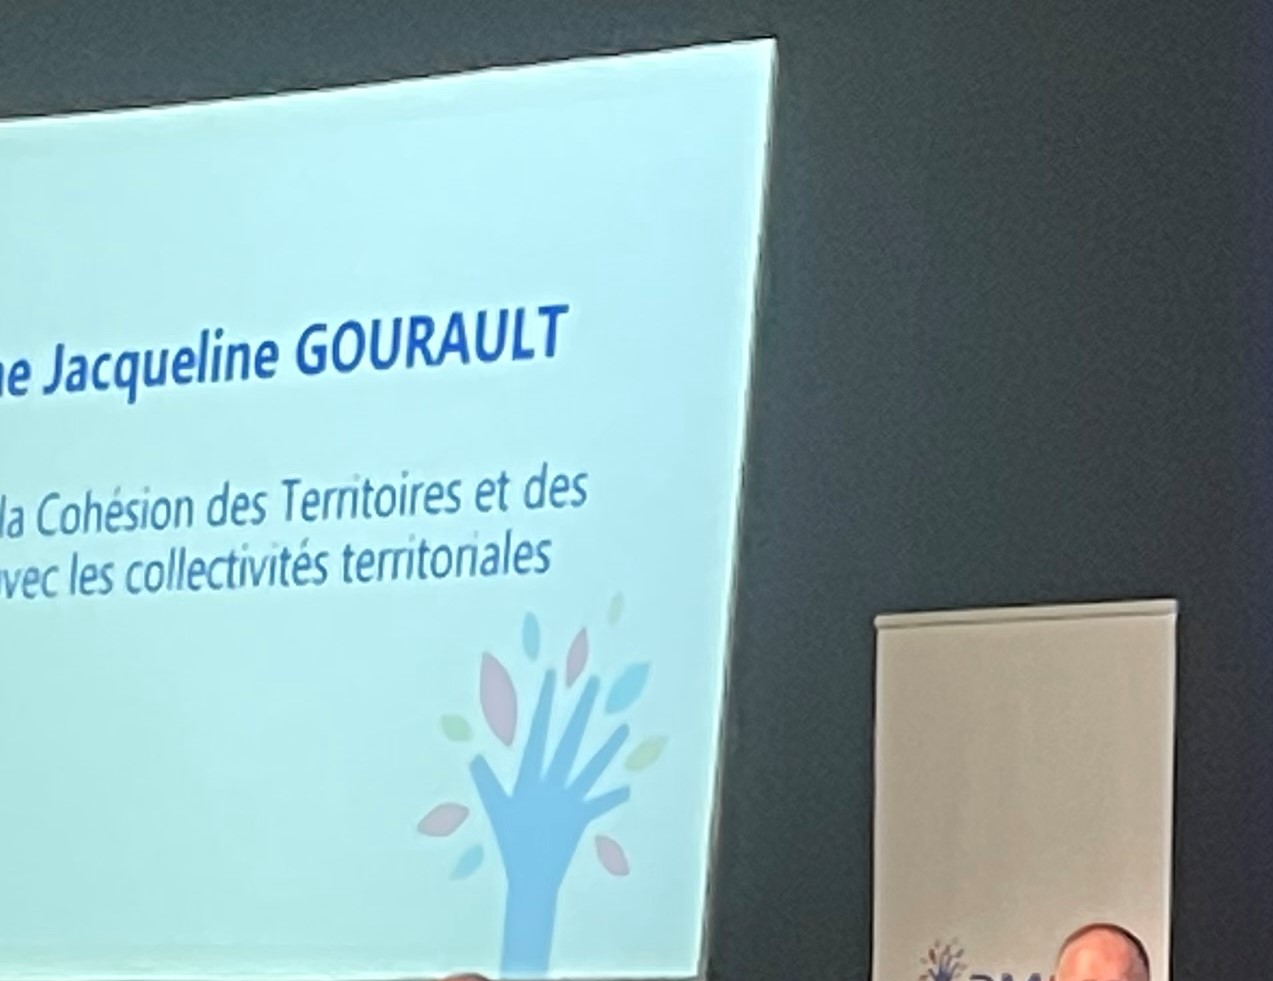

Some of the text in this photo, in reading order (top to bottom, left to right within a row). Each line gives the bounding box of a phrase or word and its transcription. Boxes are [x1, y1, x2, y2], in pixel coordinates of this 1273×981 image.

[42, 327, 280, 404] Jacqueline
[296, 304, 570, 375] GOURAULT
[0, 461, 589, 538] la Cohésion des Territoires et des
[70, 551, 115, 596] les
[126, 537, 329, 594] collectivités
[342, 528, 552, 584] territoriales
